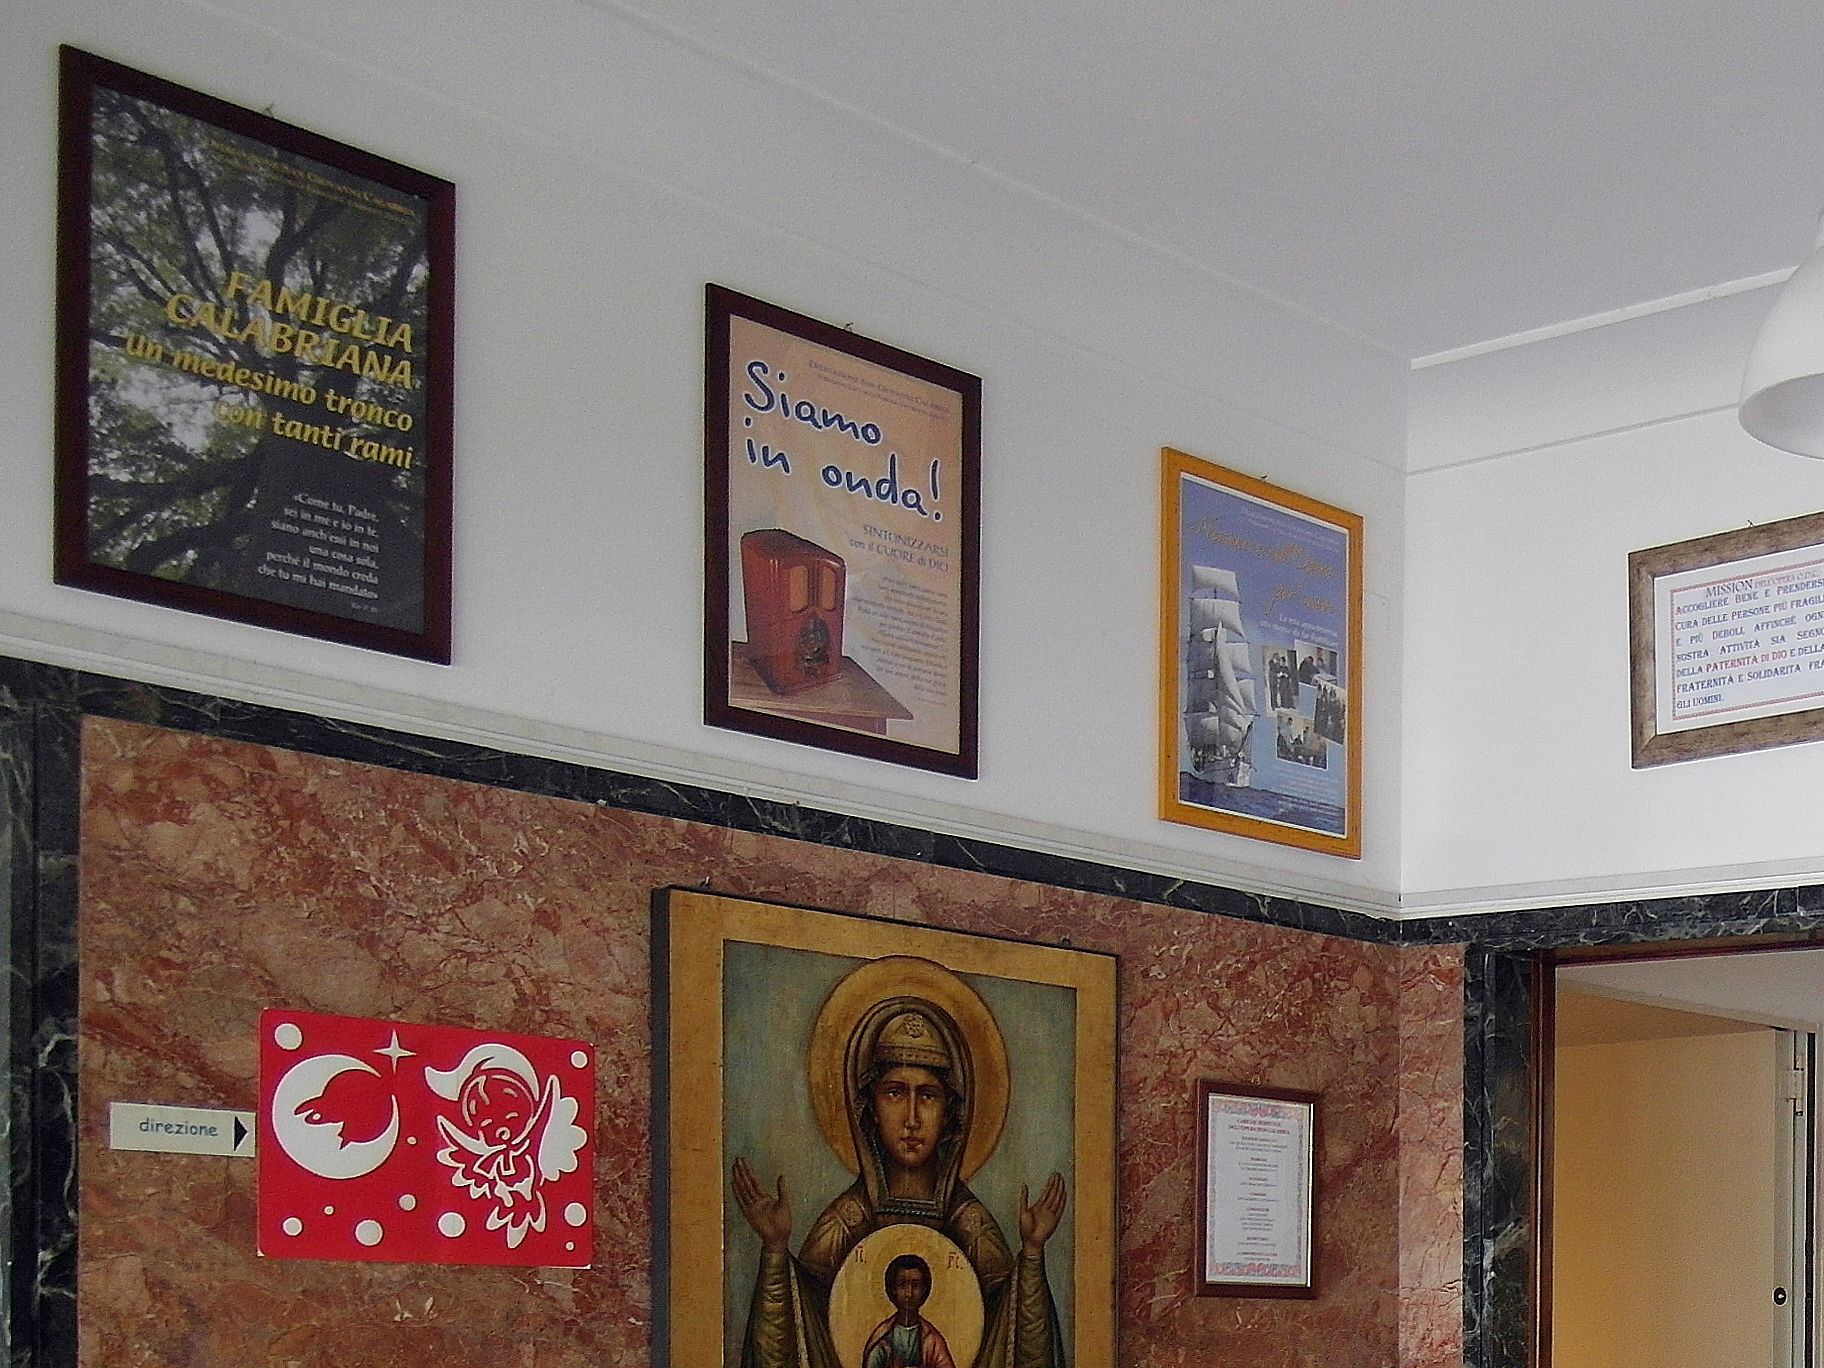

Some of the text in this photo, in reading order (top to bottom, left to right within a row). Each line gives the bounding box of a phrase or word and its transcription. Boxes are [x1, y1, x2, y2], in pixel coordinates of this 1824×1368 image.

[226, 272, 413, 353] FAMIGLIA
[165, 294, 412, 389] CALABRIANA
[125, 332, 413, 432] un medesimo tronco
[743, 360, 882, 444] Siamo
[213, 402, 413, 469] con tanti rami
[744, 416, 944, 521] in onda!
[863, 524, 948, 557] SINTONIZZARSI
[1676, 597, 1729, 615] ACCOGLIERE
[1736, 592, 1758, 604] BENE
[1765, 589, 1770, 597] E
[1705, 579, 1753, 598] MISSION
[1675, 619, 1699, 631] CURA
[1702, 613, 1728, 626] DELLE
[1731, 605, 1770, 621] PERSONE
[1676, 638, 1682, 647] E
[1676, 649, 1709, 663] NOSTRA
[1771, 634, 1786, 646] SIA
[1676, 665, 1703, 678] DELLA
[1761, 653, 1770, 663] DI
[1772, 650, 1787, 661] DIO
[1790, 648, 1796, 657] E
[1738, 674, 1744, 683] E
[1676, 698, 1691, 709] GLI
[138, 1117, 219, 1139] direzione
